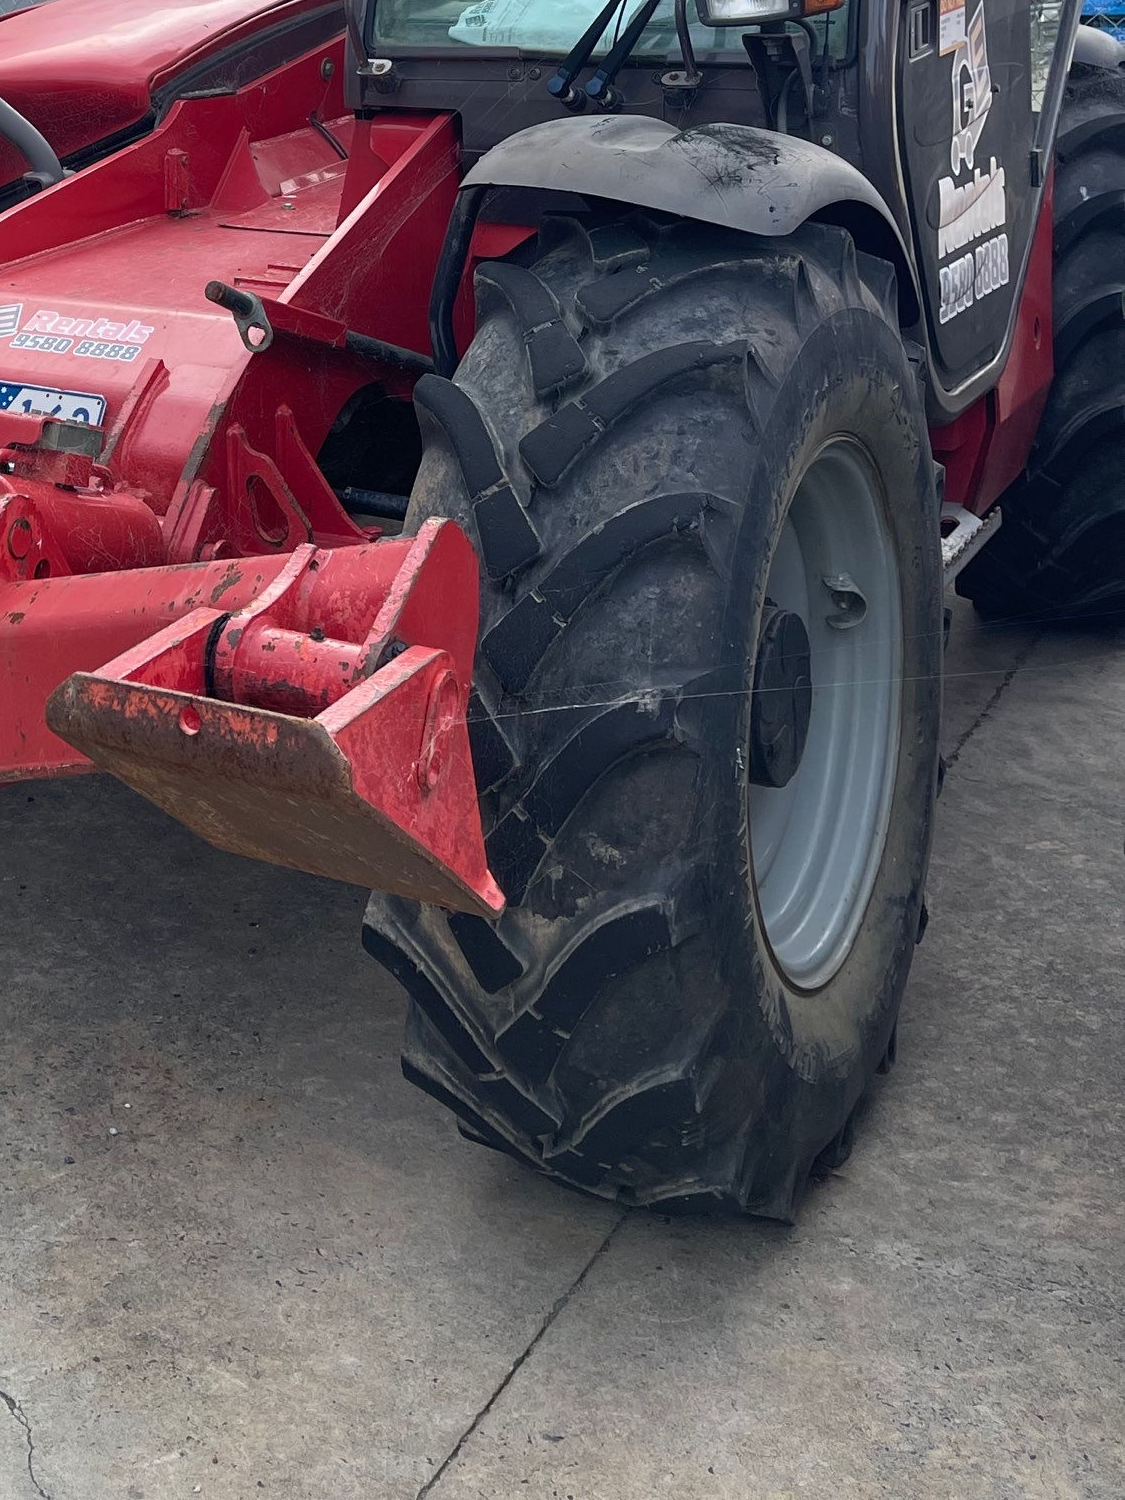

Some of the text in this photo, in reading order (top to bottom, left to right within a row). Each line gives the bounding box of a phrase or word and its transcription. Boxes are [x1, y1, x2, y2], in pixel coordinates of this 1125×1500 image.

[975, 233, 1010, 300] 8888
[22, 310, 154, 343] Rentals
[10, 332, 140, 362] 9580 8888
